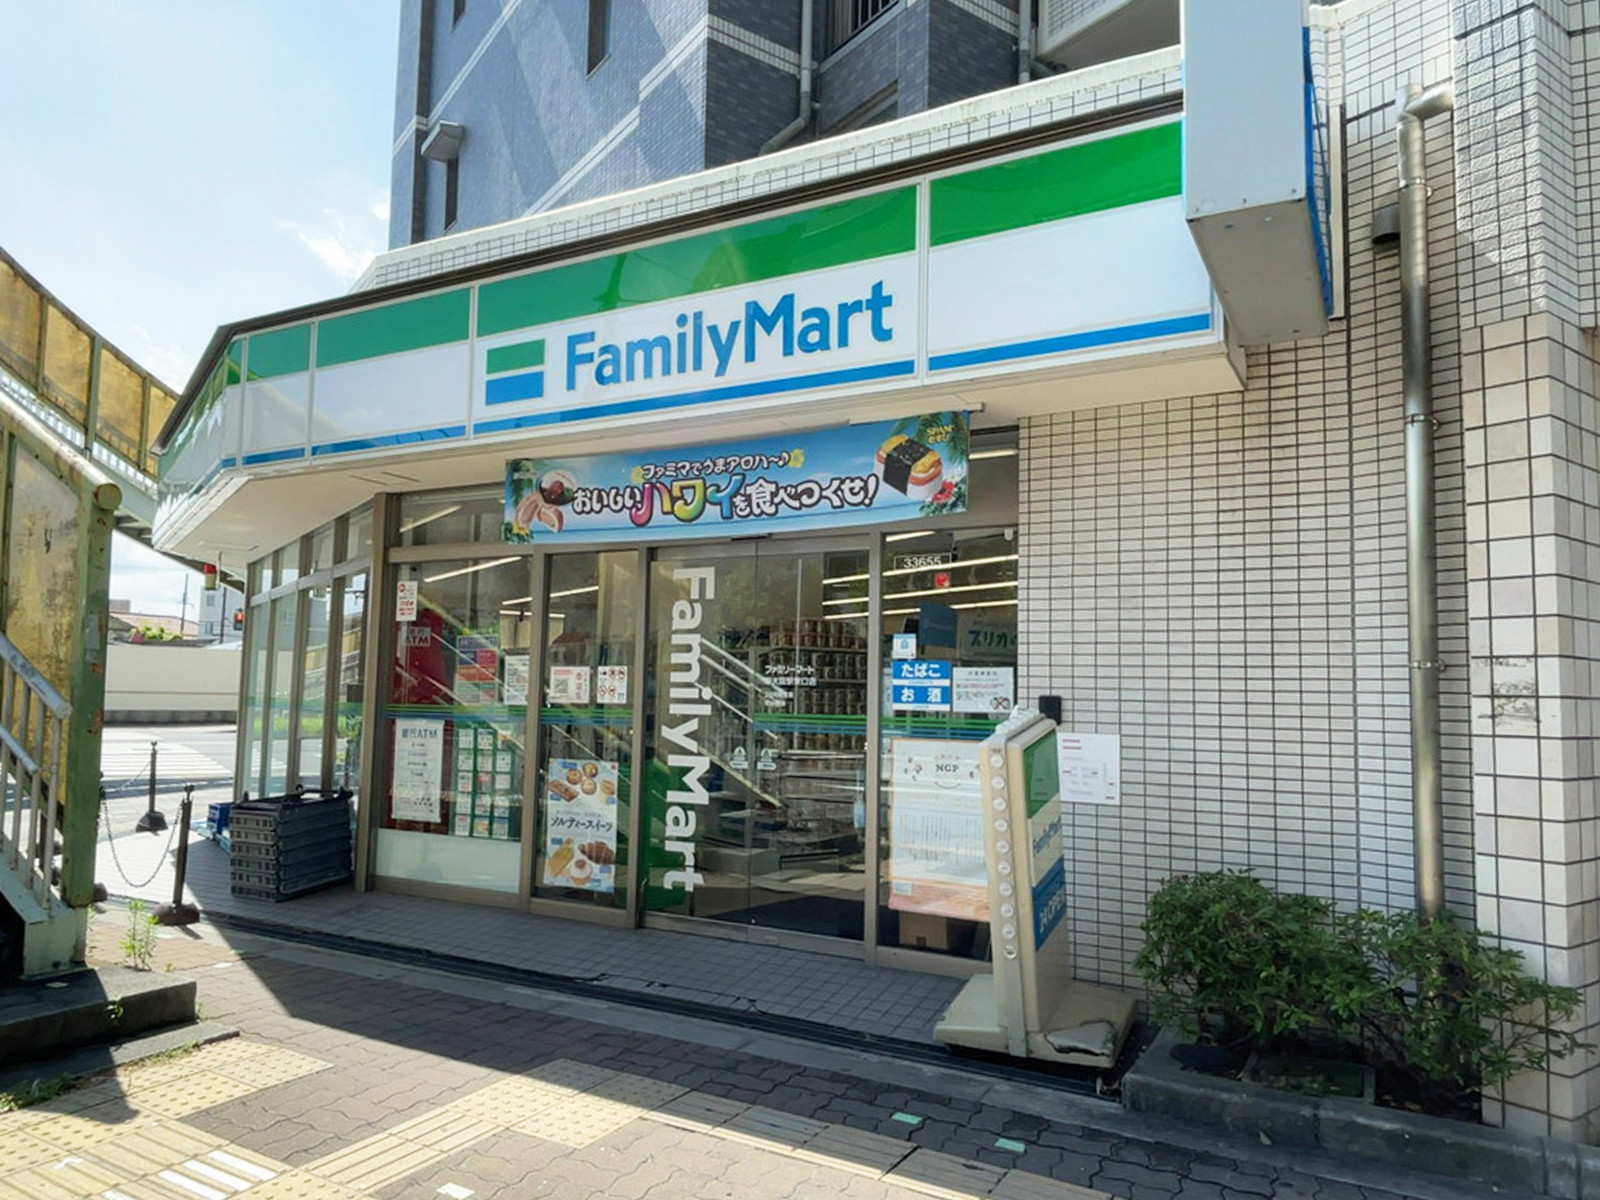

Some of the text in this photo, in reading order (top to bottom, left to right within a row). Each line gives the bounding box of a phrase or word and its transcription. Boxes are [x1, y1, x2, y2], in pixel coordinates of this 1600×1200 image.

[566, 280, 893, 391] FamilyMart
[764, 664, 815, 675] ファミリーマート
[901, 664, 942, 678] たばこ
[900, 687, 942, 703] お酒
[661, 566, 715, 892] FamilyMart
